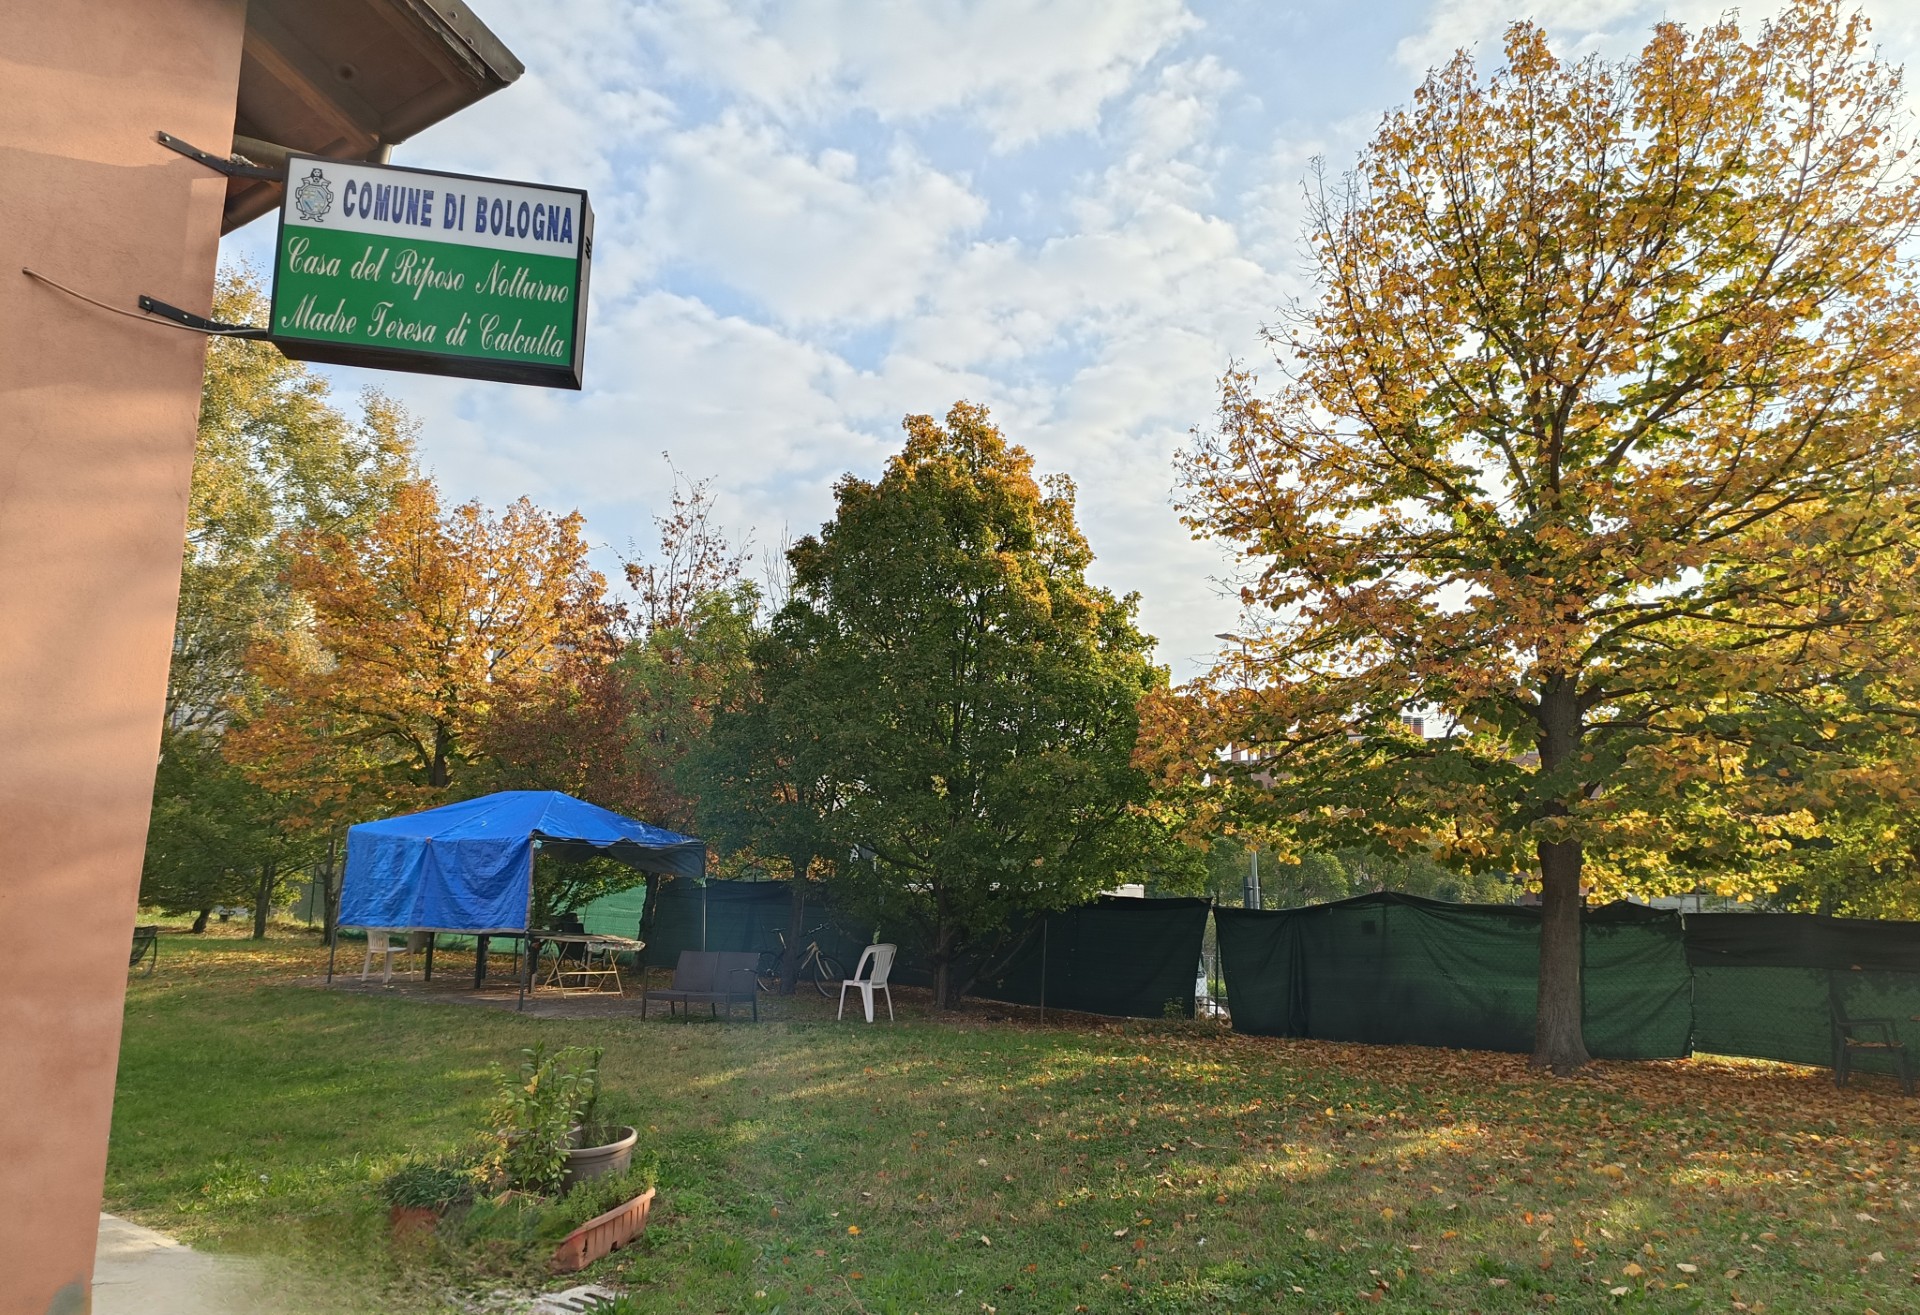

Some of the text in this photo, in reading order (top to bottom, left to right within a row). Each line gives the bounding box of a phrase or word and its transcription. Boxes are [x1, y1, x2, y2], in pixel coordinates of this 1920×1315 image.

[342, 178, 573, 244] COMUNE DI BOLOGNA
[287, 236, 569, 304] Casa del Riposo Notturno
[281, 293, 565, 359] Madre Teresa di Calcutta
